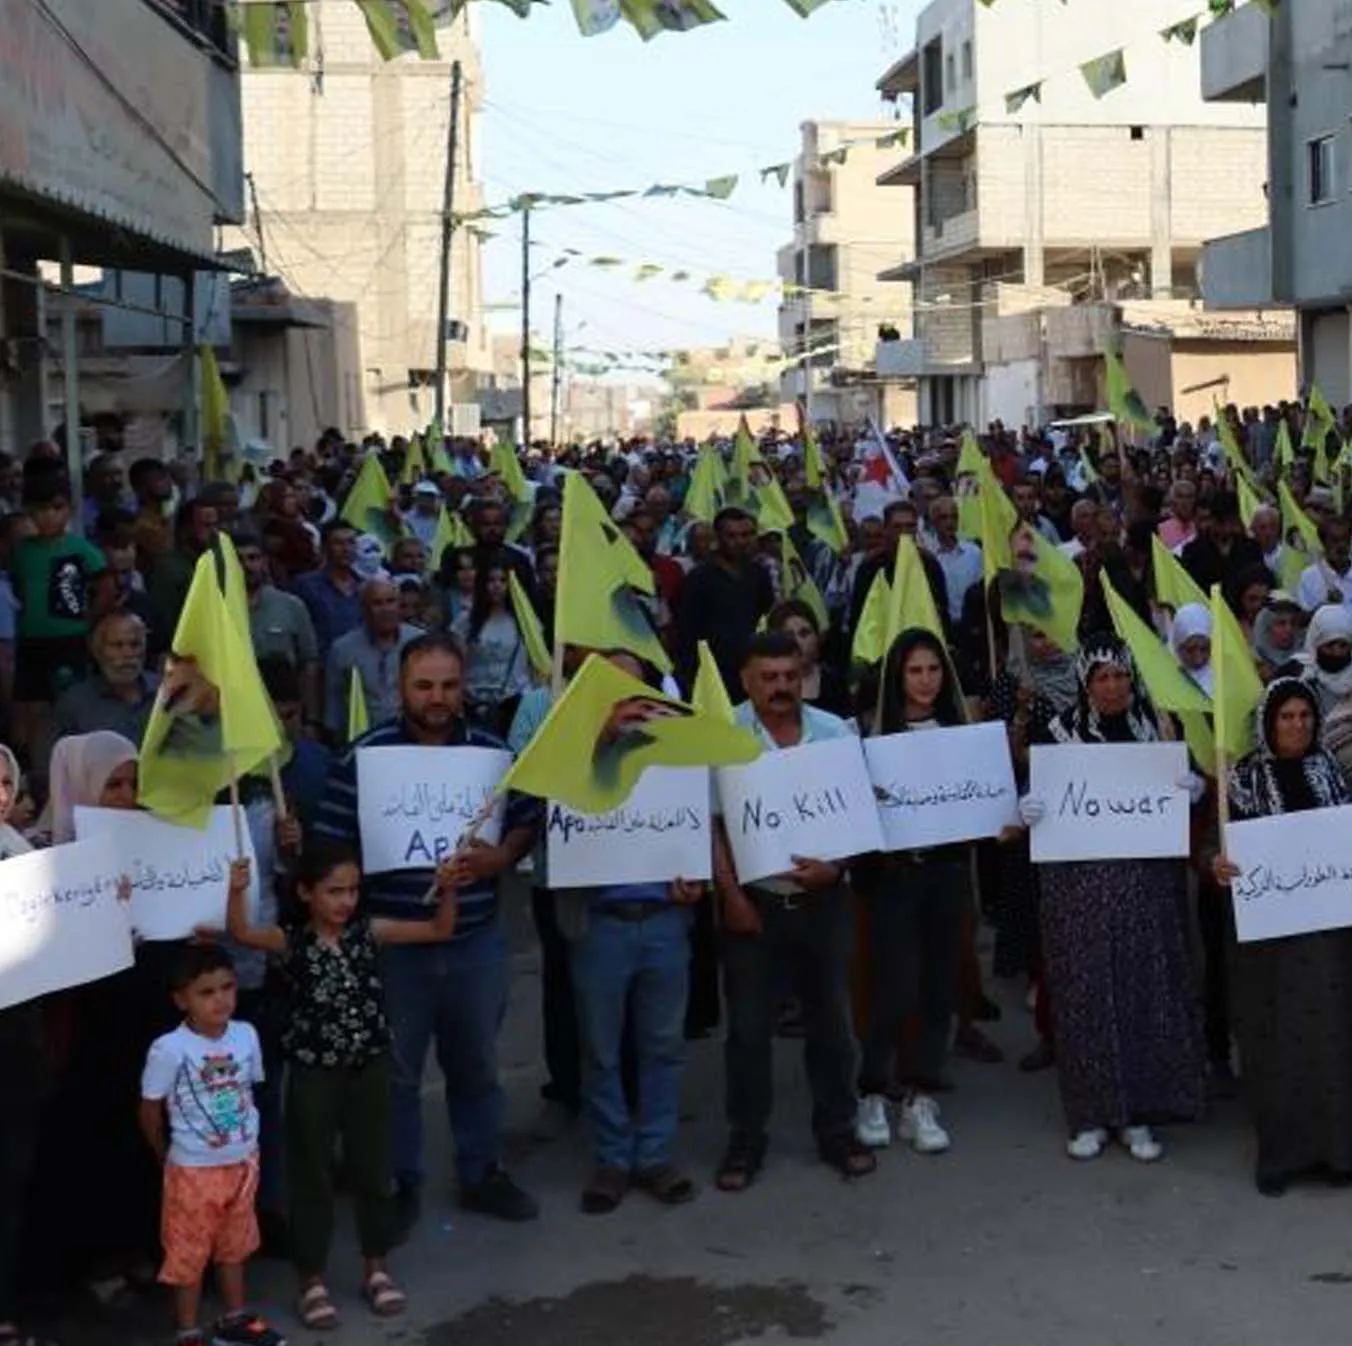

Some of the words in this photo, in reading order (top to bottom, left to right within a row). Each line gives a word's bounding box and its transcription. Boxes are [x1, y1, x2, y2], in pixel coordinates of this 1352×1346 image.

[741, 793, 782, 836] No
[792, 785, 849, 823] Kill
[1057, 777, 1102, 818] No
[548, 803, 586, 844] Apo
